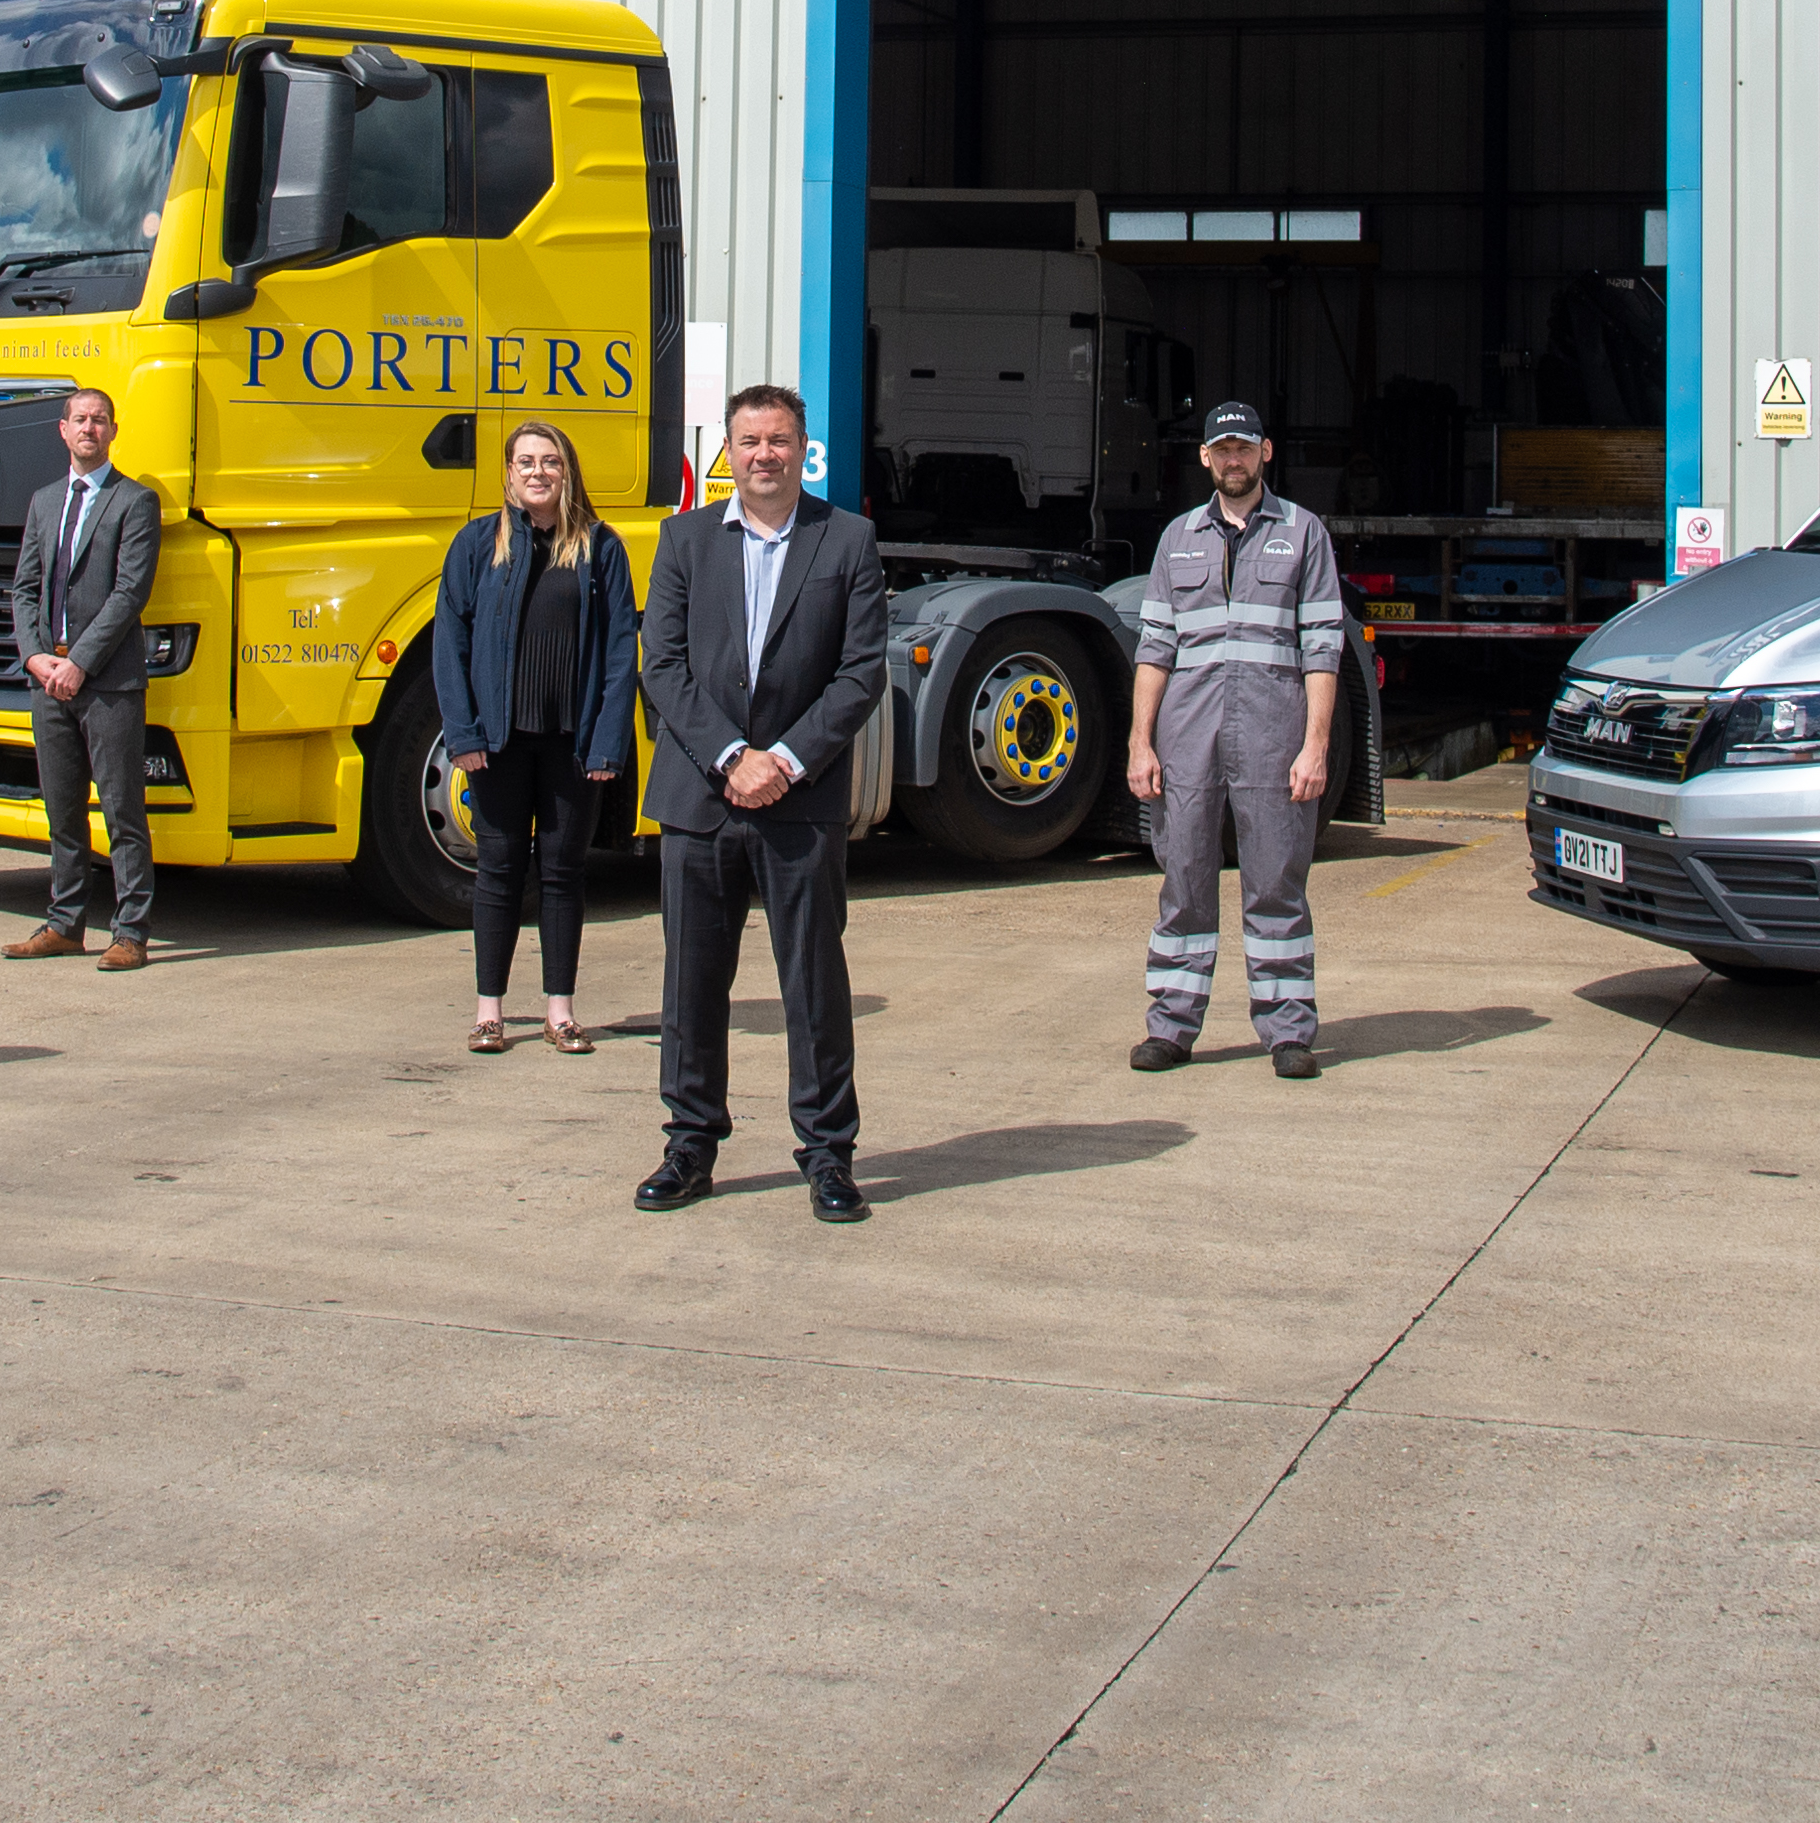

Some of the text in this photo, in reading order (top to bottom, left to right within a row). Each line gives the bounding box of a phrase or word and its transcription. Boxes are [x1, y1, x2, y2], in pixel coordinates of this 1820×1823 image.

[55, 339, 102, 359] feeds
[242, 326, 634, 399] PORTERS
[1216, 413, 1247, 424] MAN
[1764, 412, 1803, 422] Warning
[801, 439, 828, 483] 3
[1265, 547, 1293, 555] MAN
[288, 609, 319, 629] Tel:
[1363, 604, 1412, 619] 62 RXX
[241, 643, 360, 664] 01522 810478
[1583, 716, 1632, 745] MAN
[1563, 834, 1617, 876] GV21 TTJ
